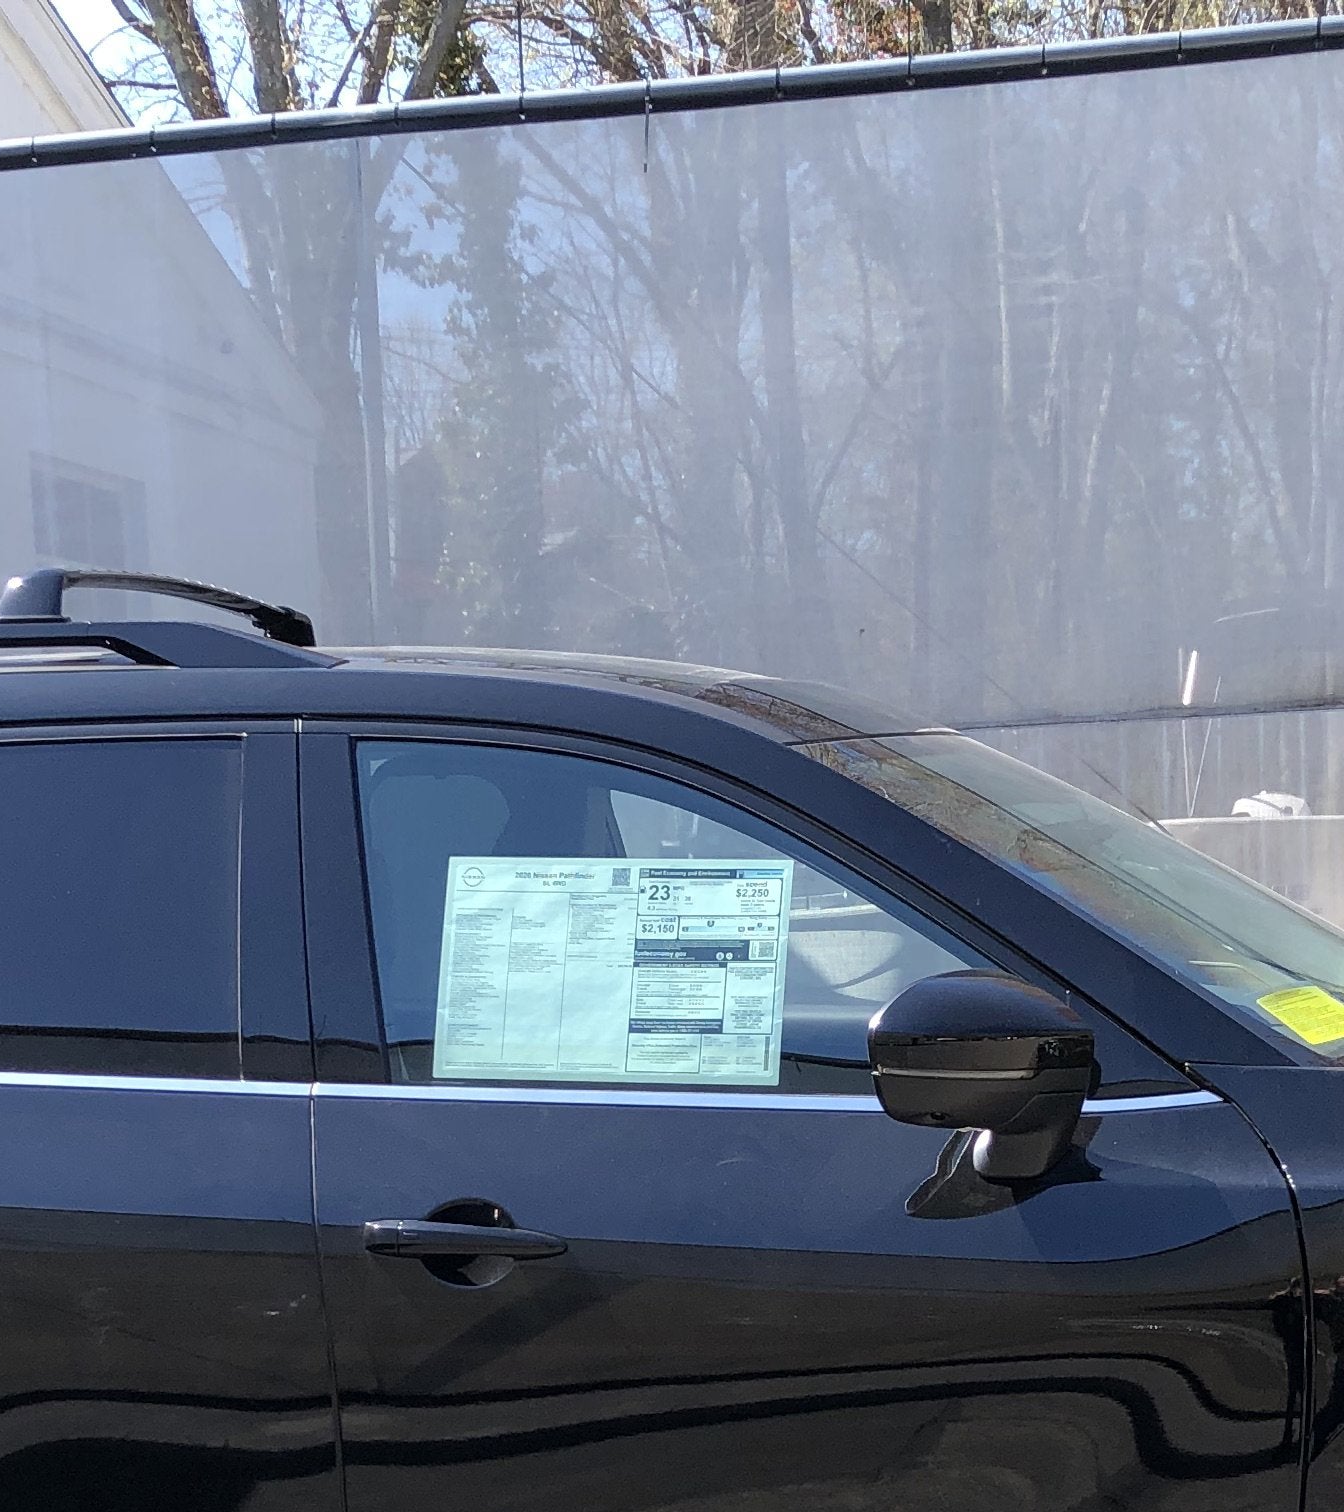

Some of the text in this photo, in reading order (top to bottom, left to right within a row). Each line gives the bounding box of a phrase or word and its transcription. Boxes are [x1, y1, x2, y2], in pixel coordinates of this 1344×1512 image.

[648, 884, 671, 901] 23
[736, 889, 769, 898] $2,250
[641, 923, 675, 935] $2,150
